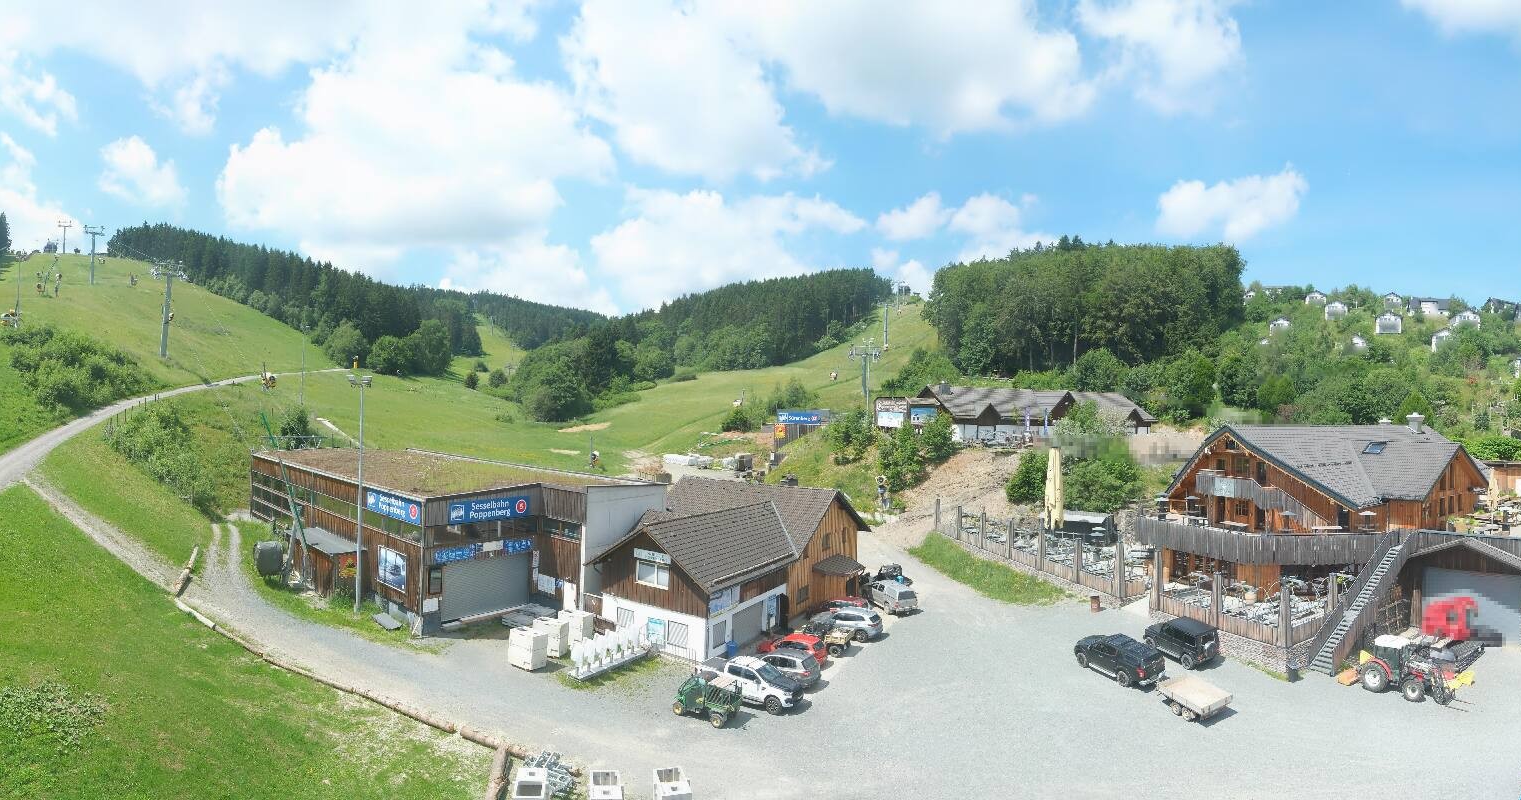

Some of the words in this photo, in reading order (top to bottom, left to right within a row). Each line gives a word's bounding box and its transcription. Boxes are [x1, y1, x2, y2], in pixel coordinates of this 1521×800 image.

[379, 494, 405, 507] Sesselbahn
[471, 500, 510, 511] Sesselbahn
[378, 502, 406, 518] Poppenberg
[469, 508, 511, 520] Poppenberg
